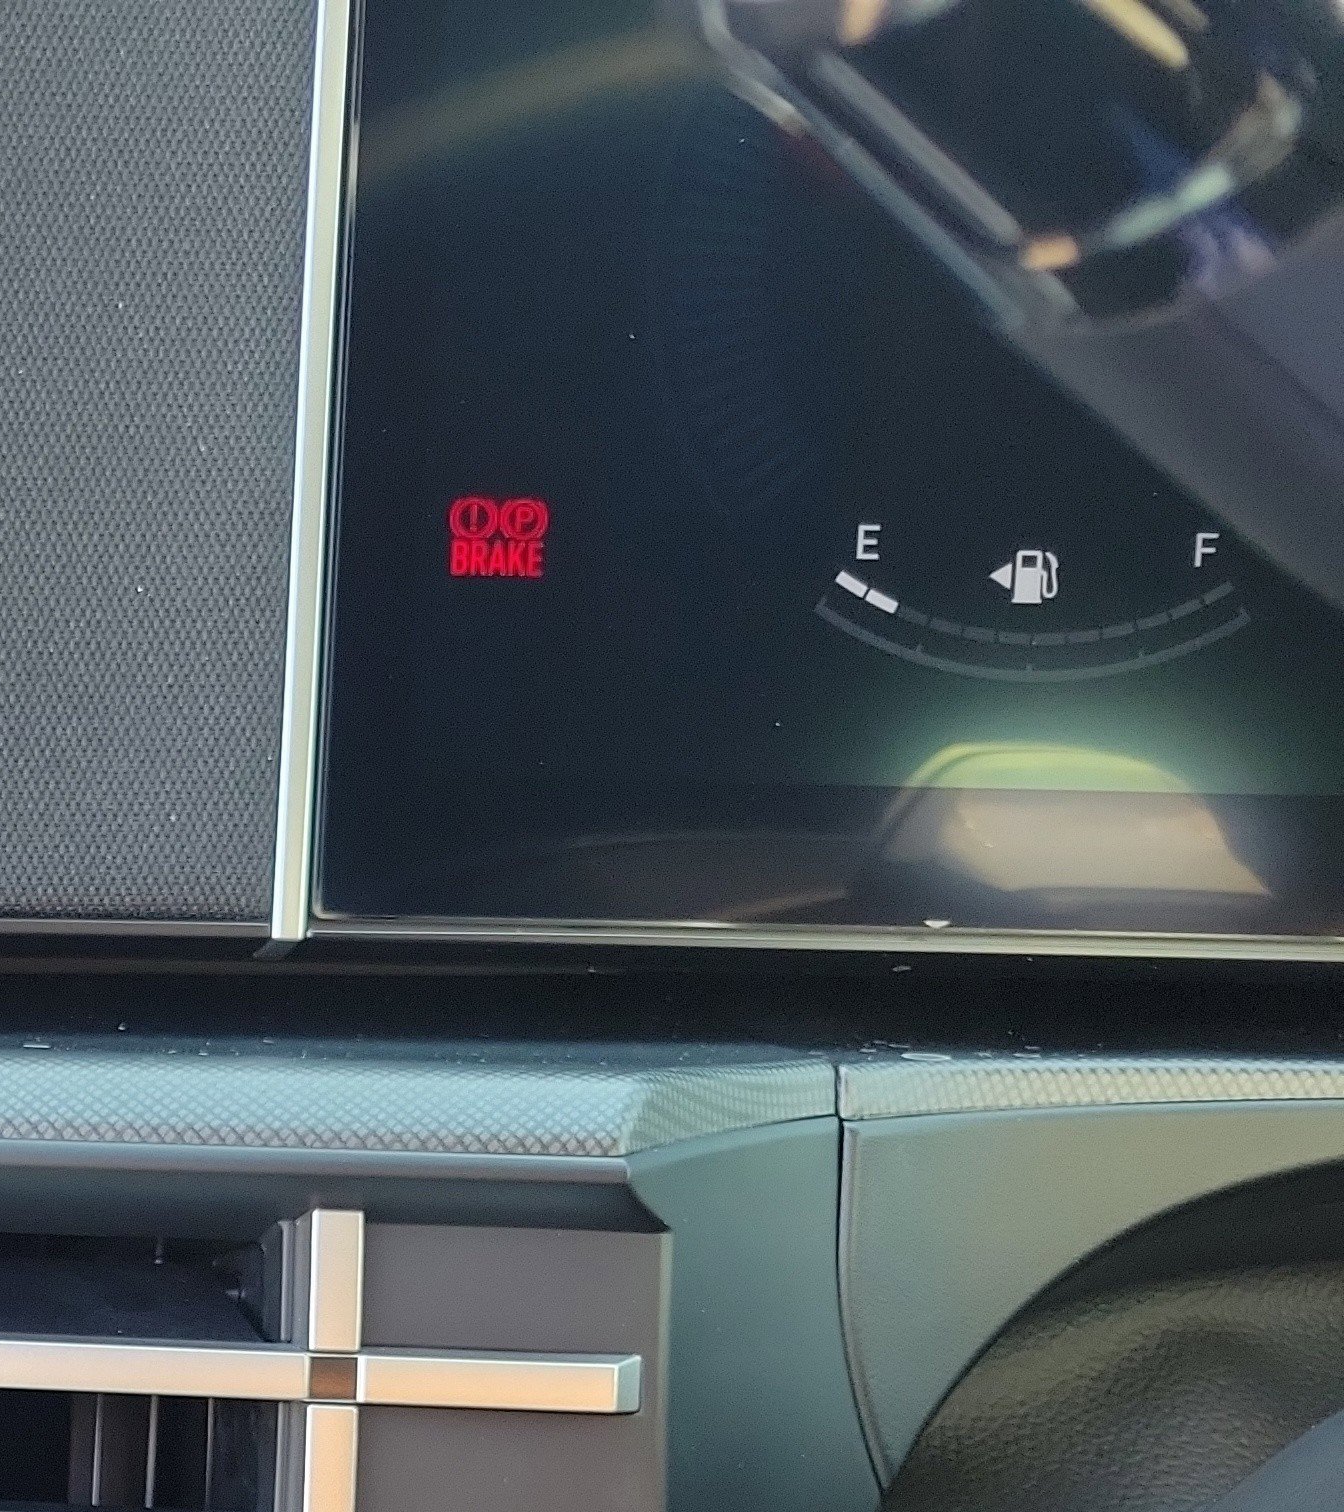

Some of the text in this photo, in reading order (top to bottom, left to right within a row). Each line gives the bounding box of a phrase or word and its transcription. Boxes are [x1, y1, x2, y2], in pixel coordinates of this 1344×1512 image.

[515, 506, 535, 533] P
[450, 540, 544, 577] BRAKE
[856, 524, 881, 560] E
[1194, 532, 1220, 568] F
